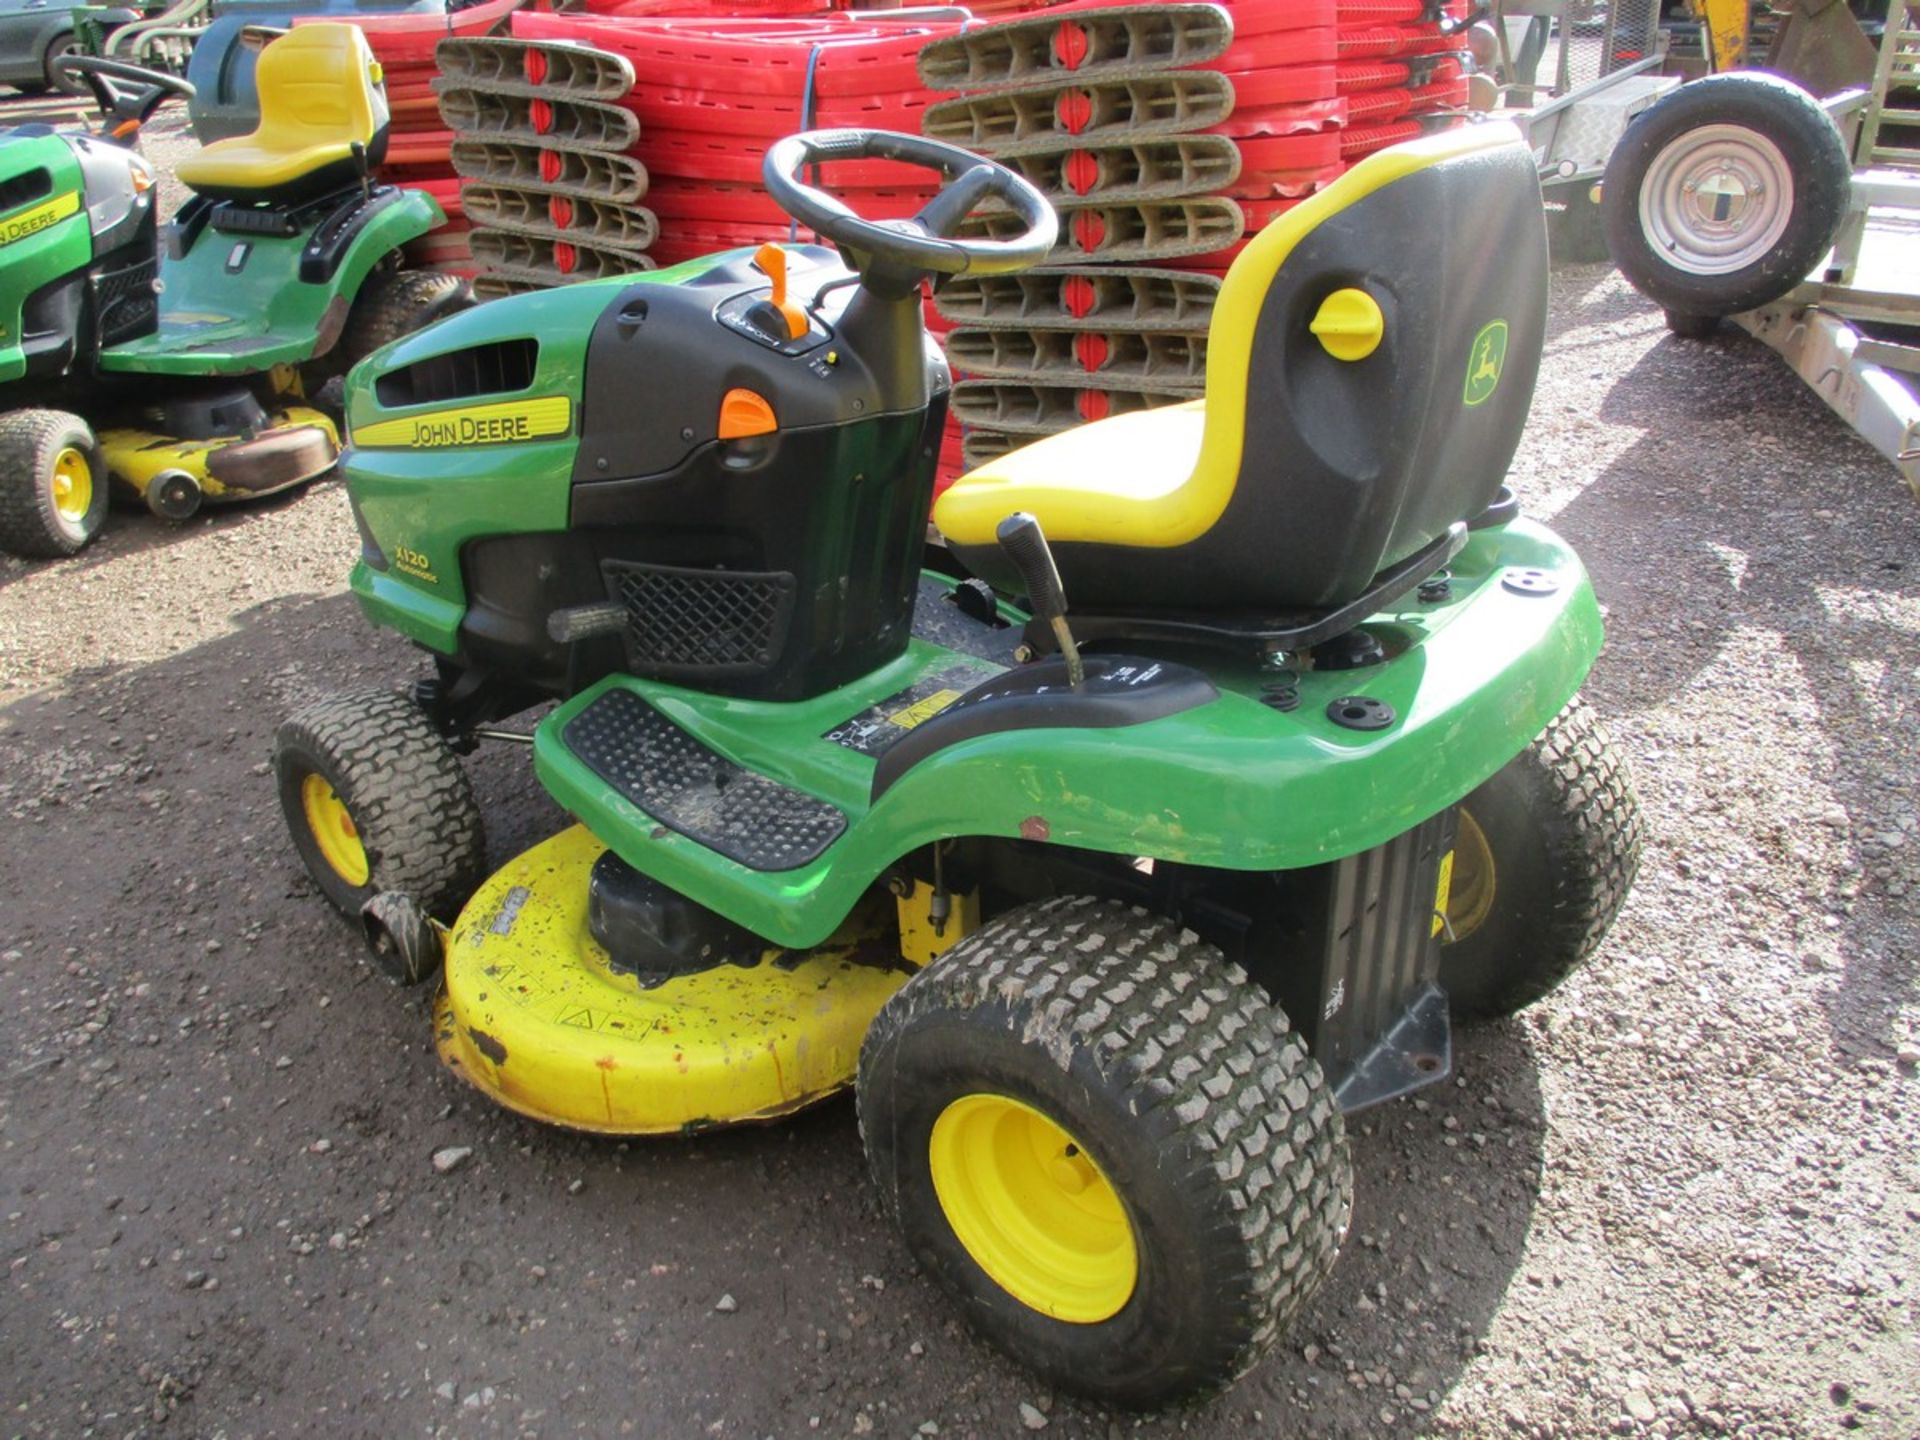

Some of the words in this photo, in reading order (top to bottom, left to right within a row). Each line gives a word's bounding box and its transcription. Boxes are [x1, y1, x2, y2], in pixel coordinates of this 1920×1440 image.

[8, 209, 57, 239] DEERE
[411, 421, 457, 444] JOHN
[460, 417, 529, 441] DEERE
